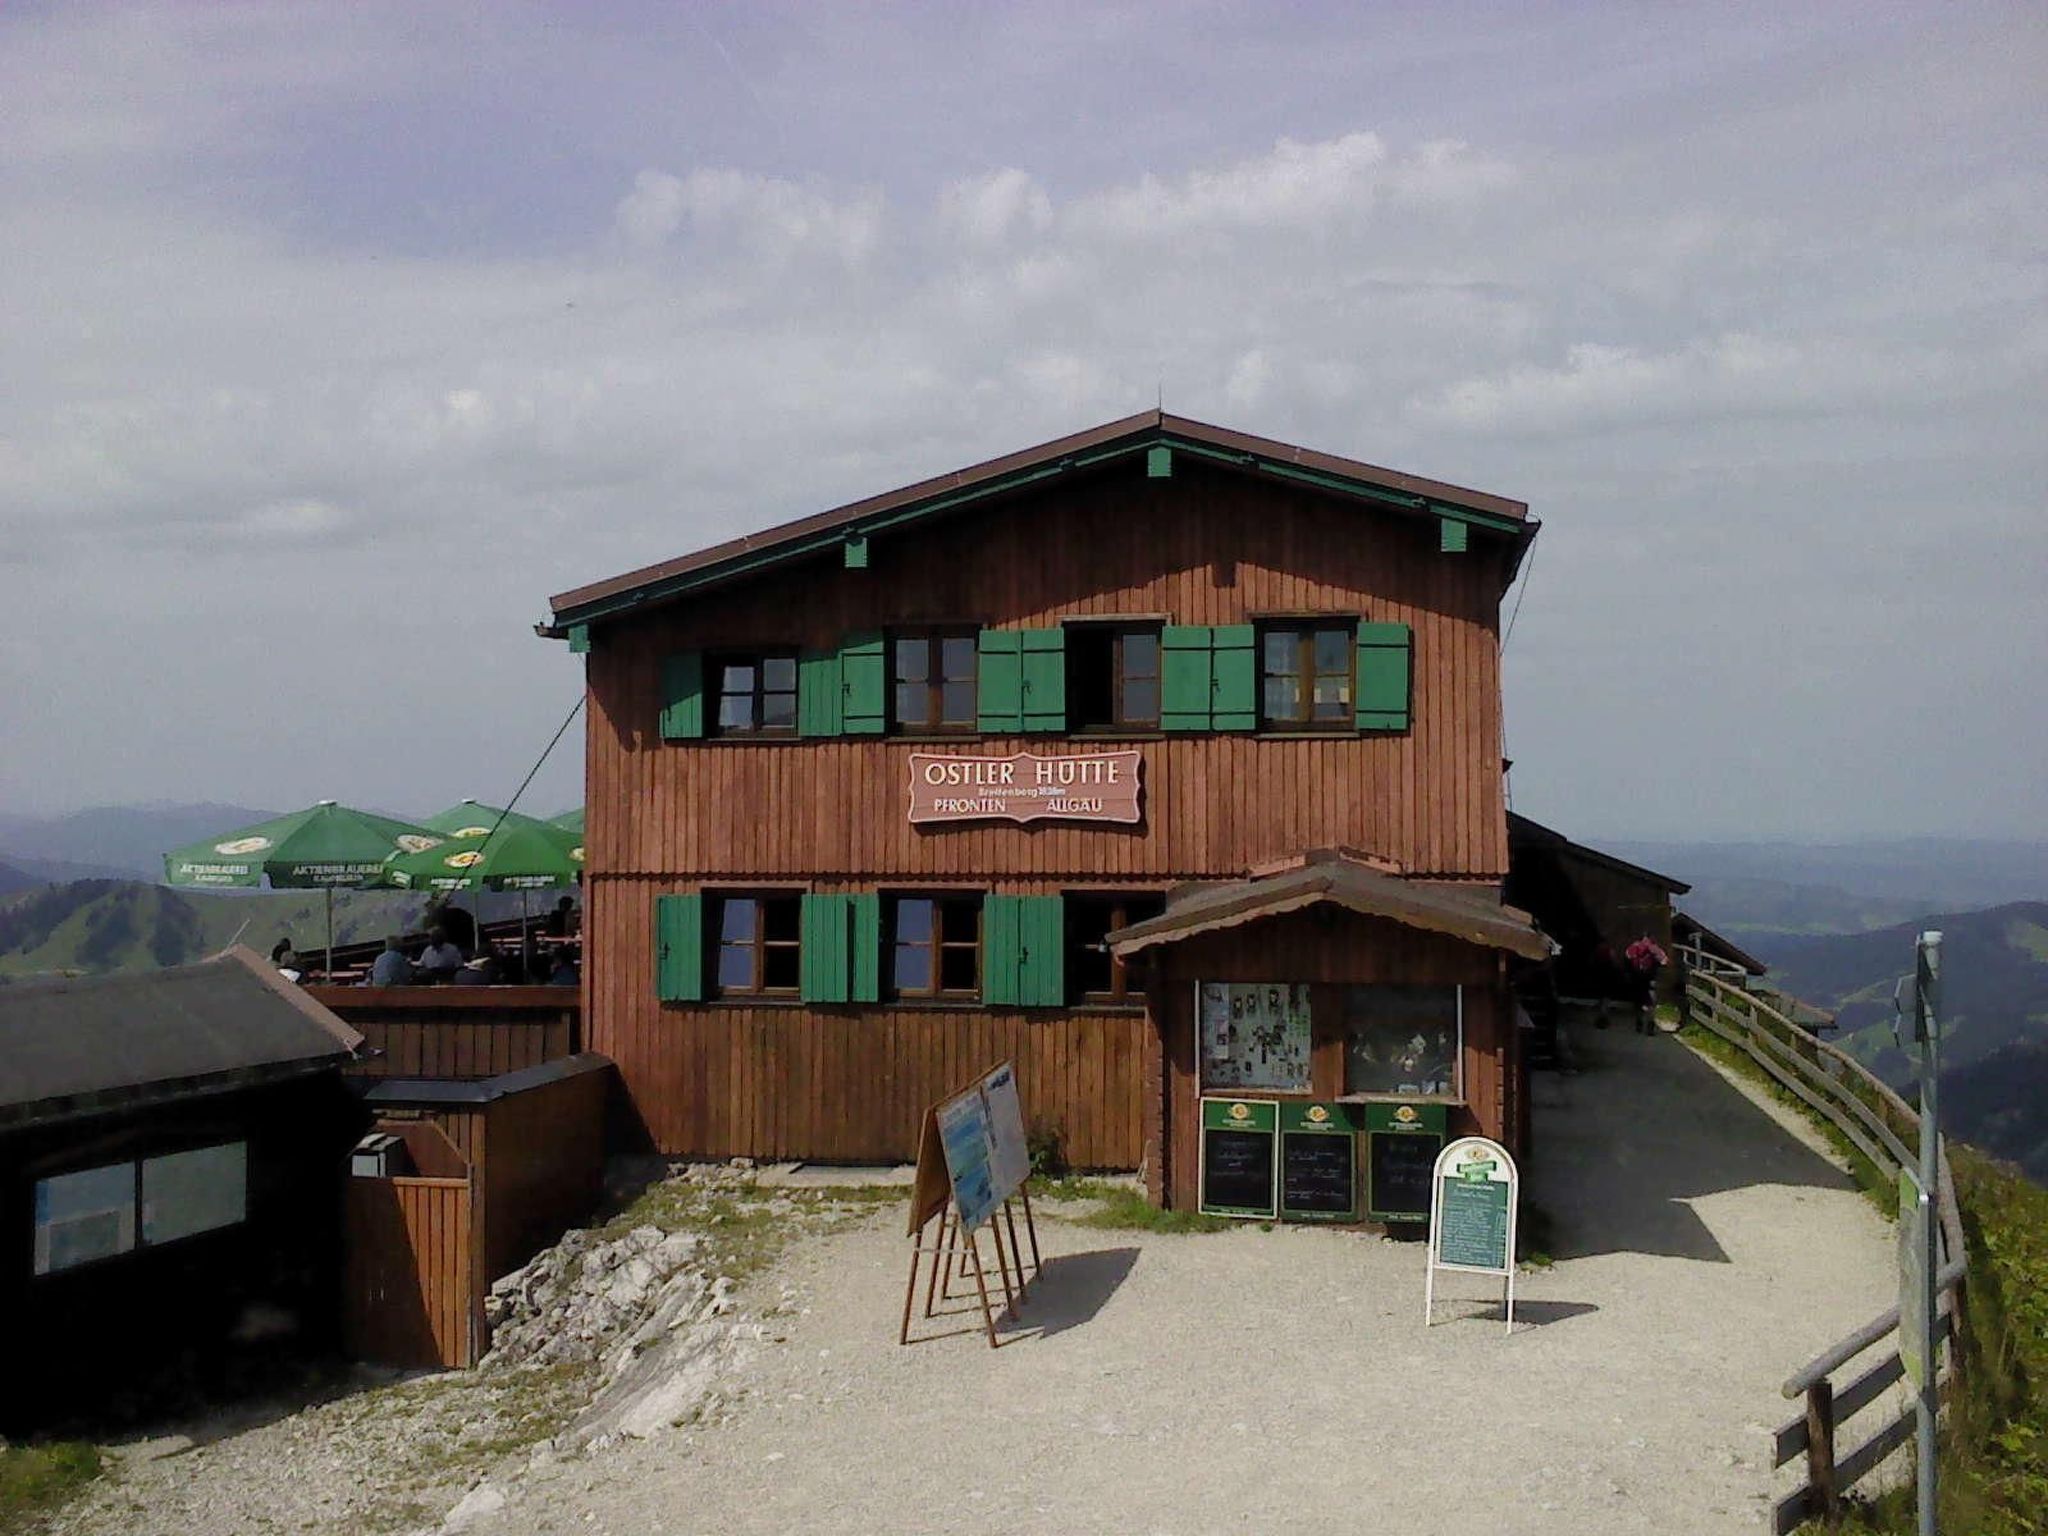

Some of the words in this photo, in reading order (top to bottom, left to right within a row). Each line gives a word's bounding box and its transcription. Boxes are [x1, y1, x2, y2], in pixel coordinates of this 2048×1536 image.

[925, 761, 1014, 785] OSTLER
[1035, 760, 1119, 785] HÜTTE
[934, 798, 1006, 813] PFRONTEN
